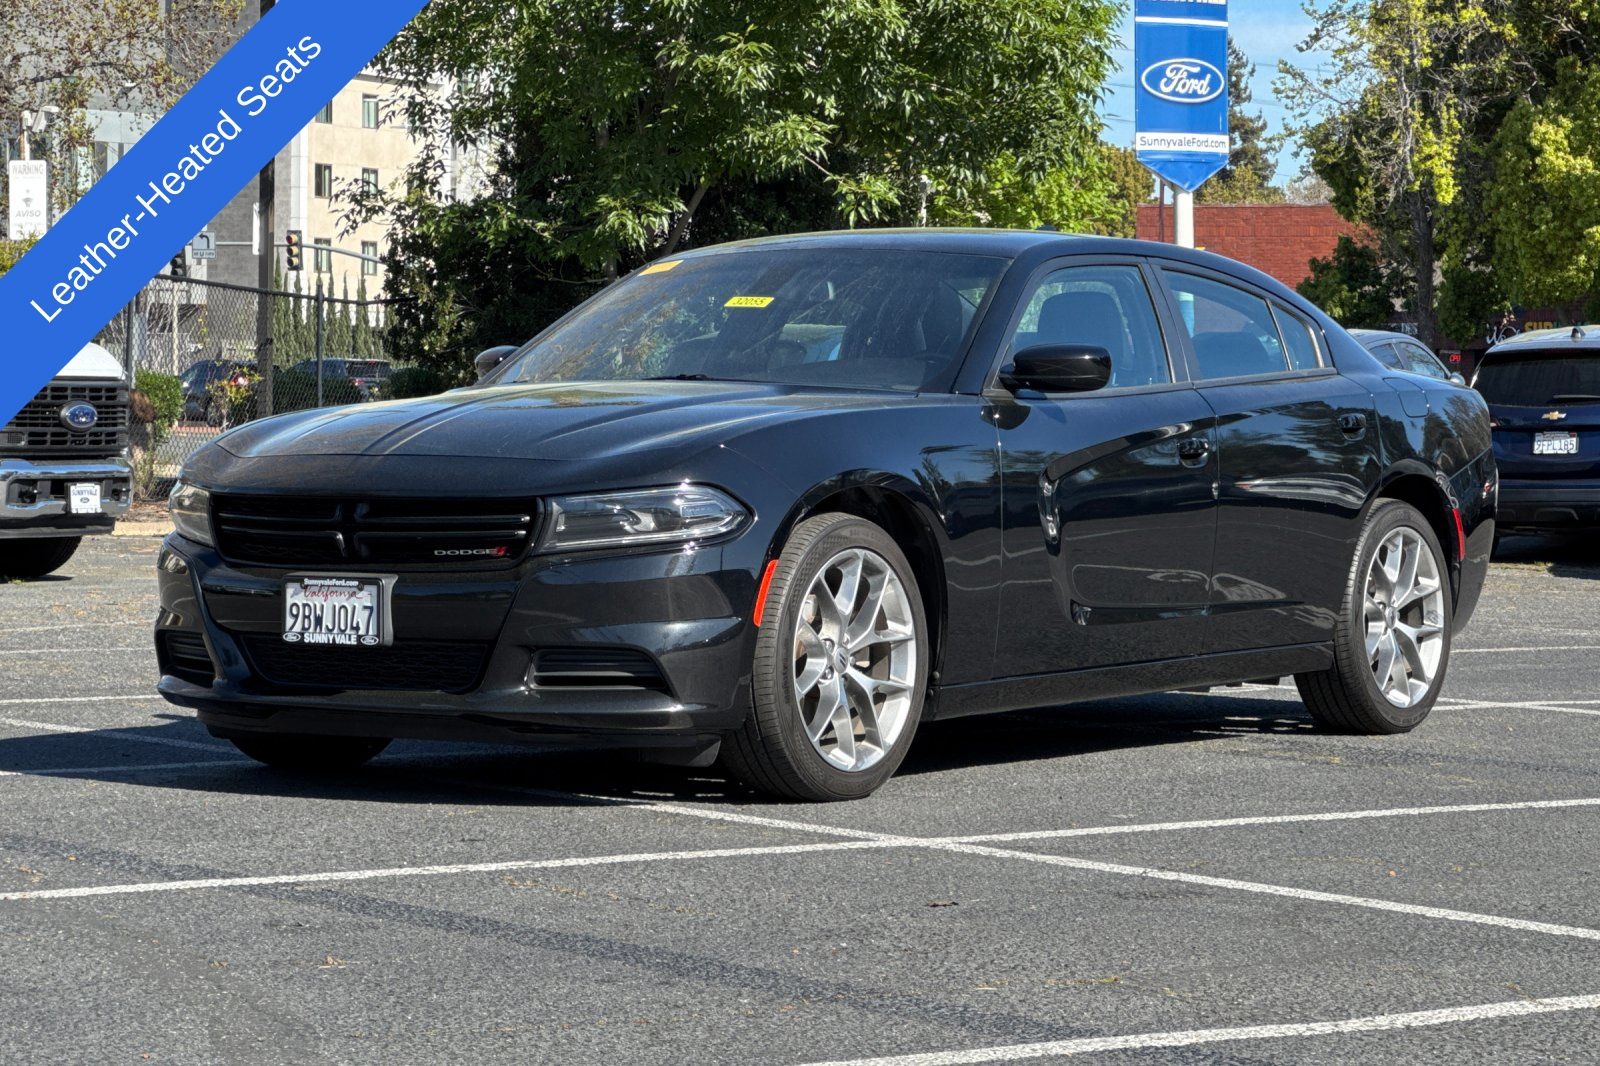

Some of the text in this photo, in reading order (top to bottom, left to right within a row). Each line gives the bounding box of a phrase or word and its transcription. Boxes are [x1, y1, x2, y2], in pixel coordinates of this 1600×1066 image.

[1159, 63, 1212, 96] Ford
[1139, 136, 1227, 149] SunnyvaleFord.com
[12, 163, 44, 175] WARNING
[15, 209, 42, 218] AVISO
[288, 602, 374, 635] 9BWJ047
[303, 633, 357, 645] SUNNYVALE
